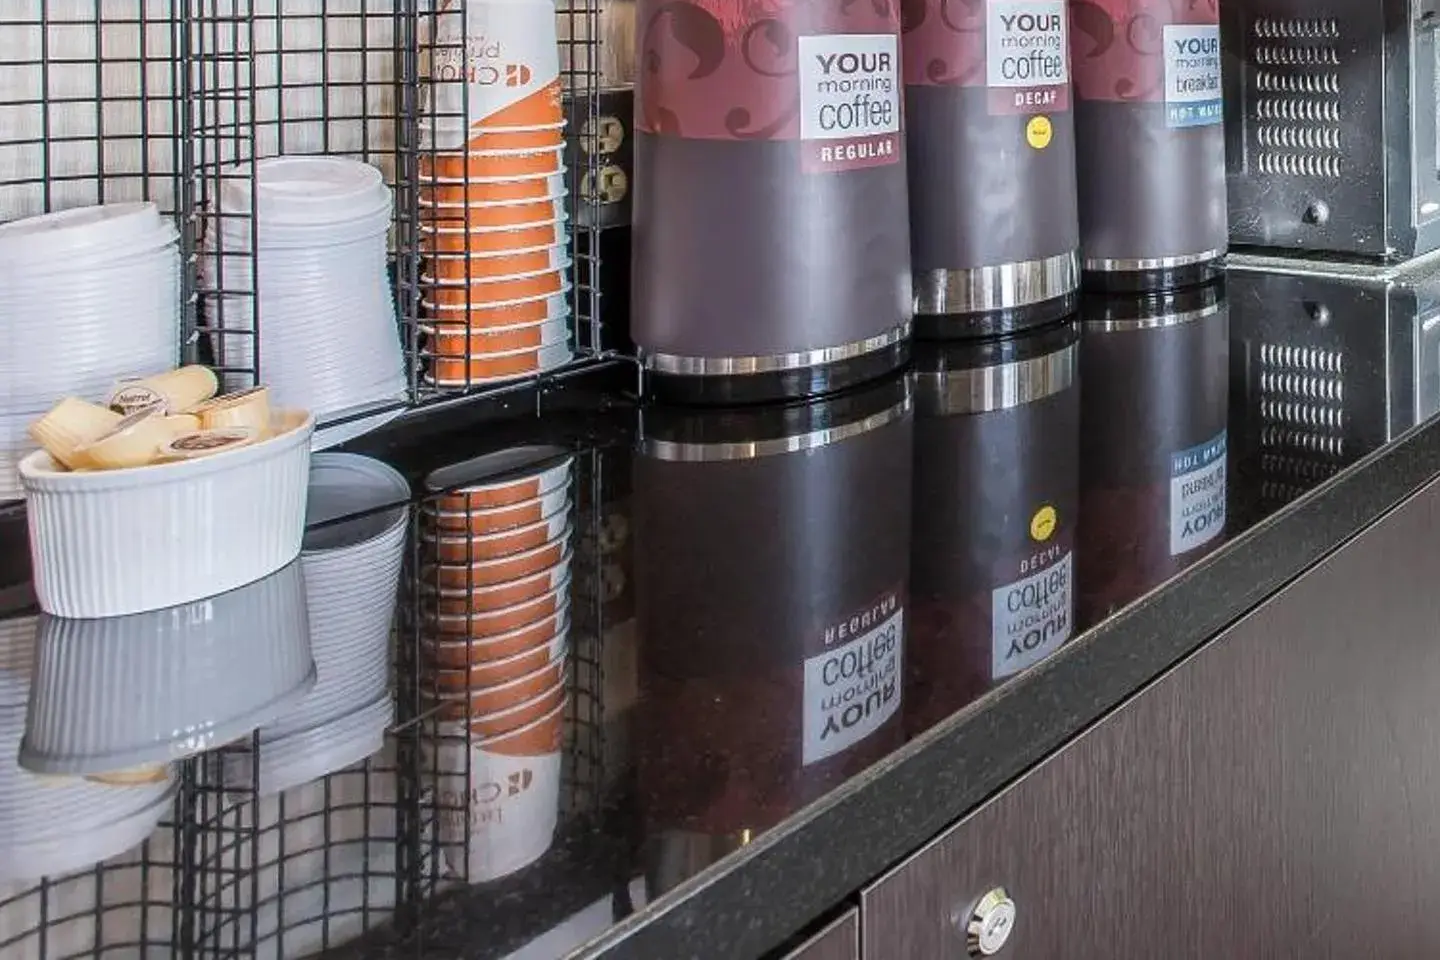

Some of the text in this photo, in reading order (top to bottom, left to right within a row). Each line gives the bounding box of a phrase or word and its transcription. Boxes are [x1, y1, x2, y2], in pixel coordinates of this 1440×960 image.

[1000, 14, 1061, 32] YOUR
[1001, 33, 1061, 50] morning
[1174, 38, 1218, 55] YOUR
[816, 52, 891, 74] YOUR
[1001, 49, 1062, 79] coffee
[817, 75, 892, 93] morning
[1014, 91, 1057, 107] DECAF
[819, 93, 892, 130] coffee
[821, 140, 893, 162] REGULAR
